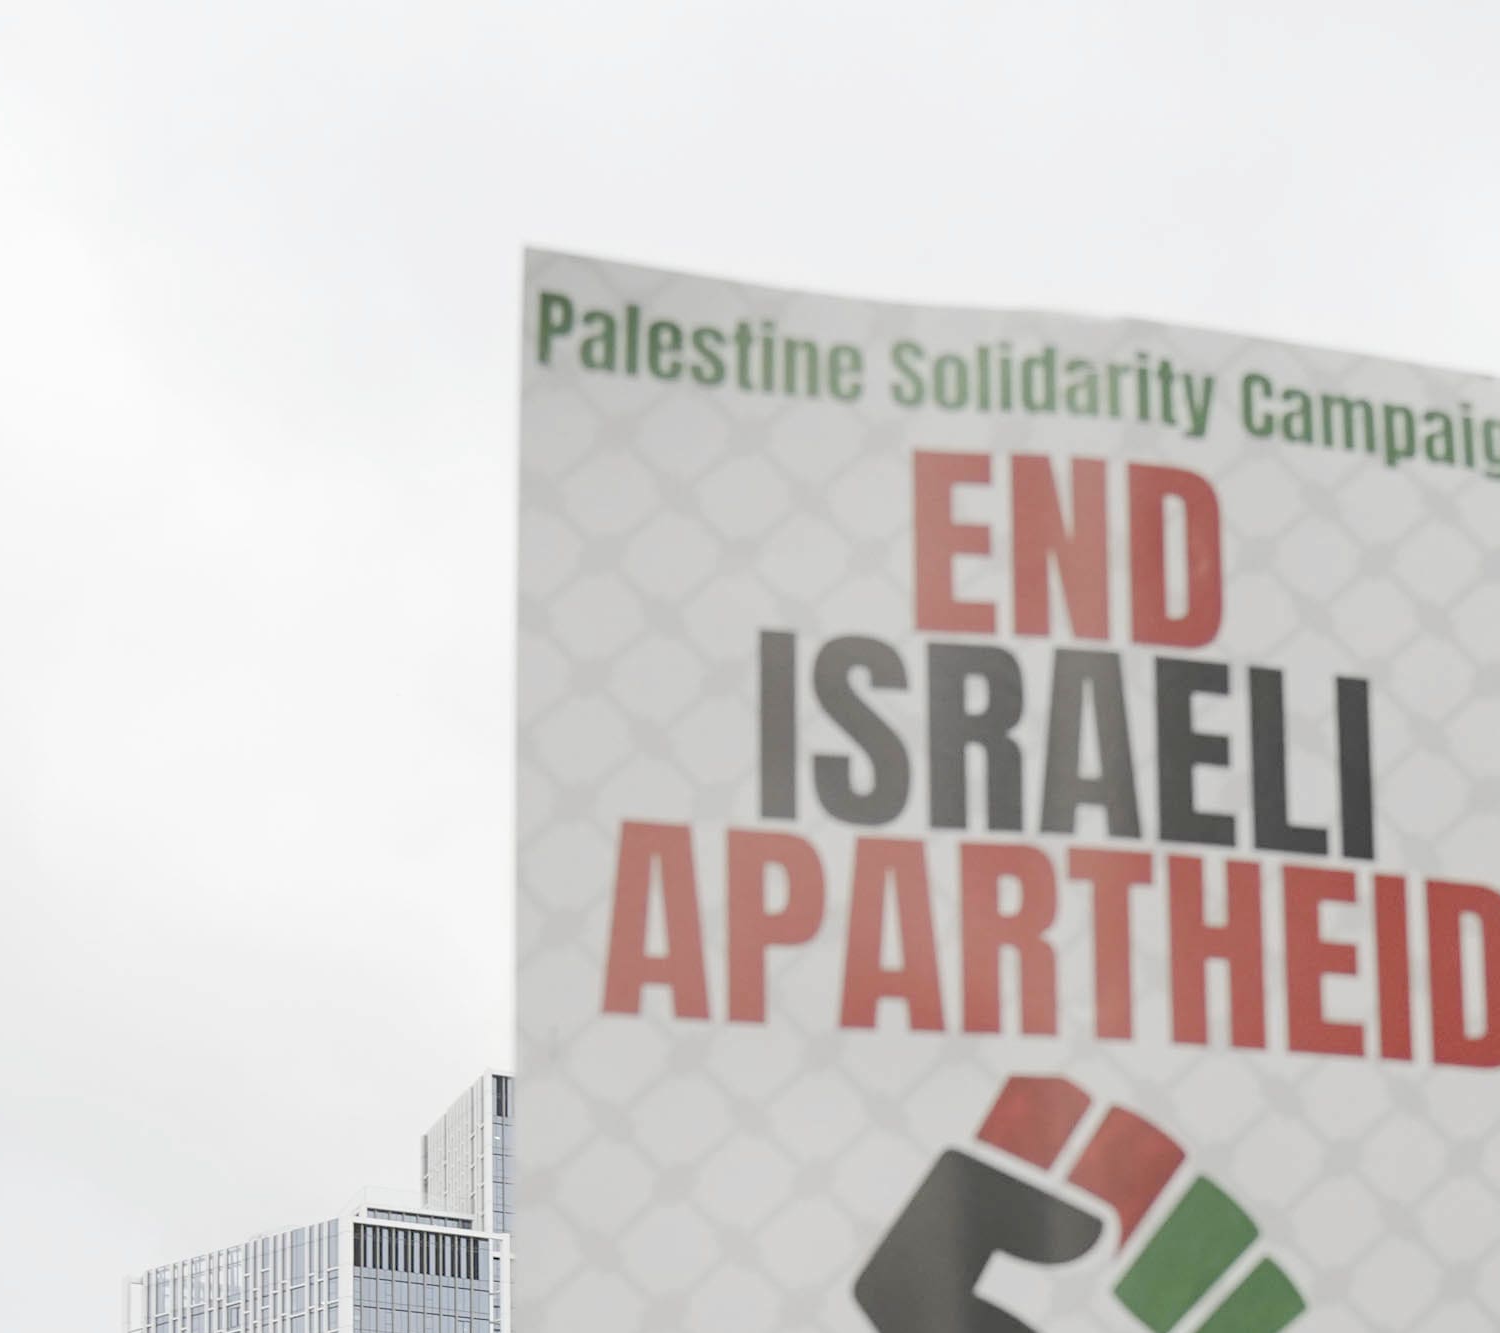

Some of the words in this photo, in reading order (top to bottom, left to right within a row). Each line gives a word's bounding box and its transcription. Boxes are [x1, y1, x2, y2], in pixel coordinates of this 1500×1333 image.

[536, 290, 864, 404] Palestine
[891, 340, 1215, 439] Solidarity
[913, 450, 1223, 649] END
[758, 630, 1374, 860] ISRAELI
